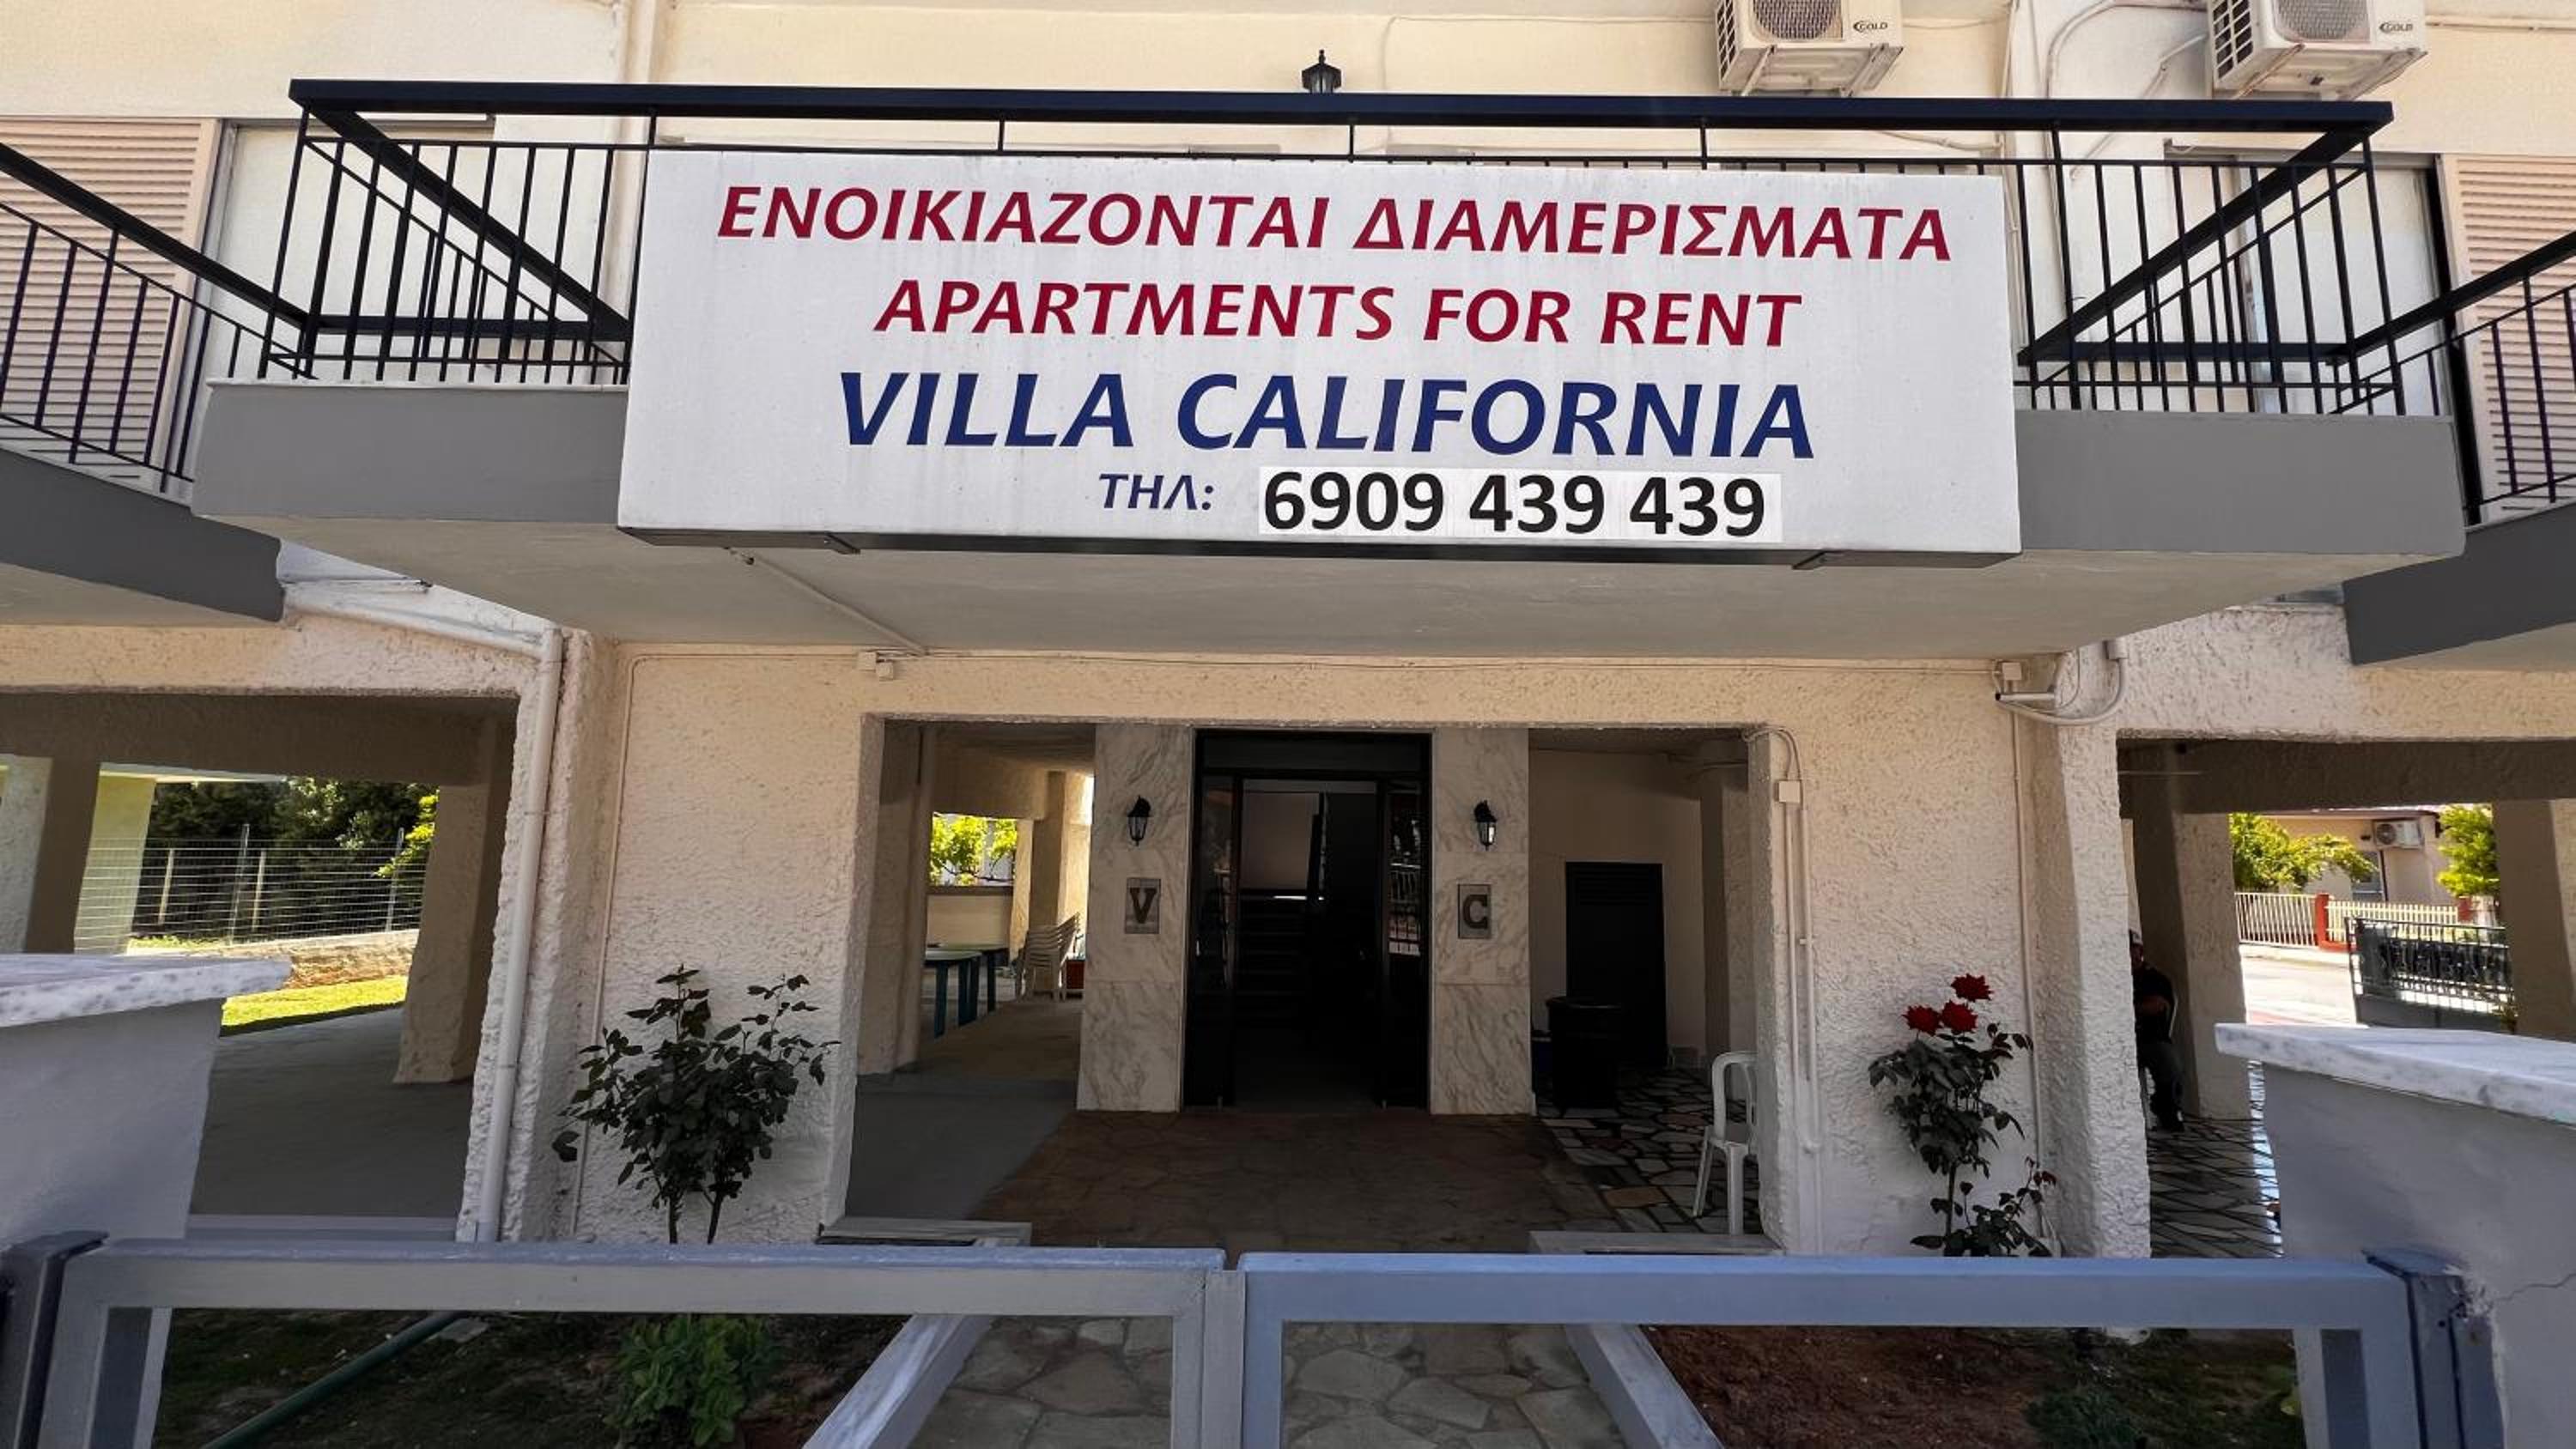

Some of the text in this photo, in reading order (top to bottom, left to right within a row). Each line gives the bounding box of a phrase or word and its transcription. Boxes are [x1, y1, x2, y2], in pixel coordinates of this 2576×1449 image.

[717, 186, 1951, 261] ΕΝΟΙΚΙΑΖΟΝΤΑΙ ΔΙΑΜΕΡΙΣΜΑΤΑ
[873, 279, 1802, 347] APARTMENTS FOR RENT
[841, 372, 1814, 459] VILLA CALIFORNIA
[1099, 471, 1765, 537] ΤΗΛ: 6909 439 439
[1129, 887, 1157, 925] V
[1462, 894, 1489, 930] C
